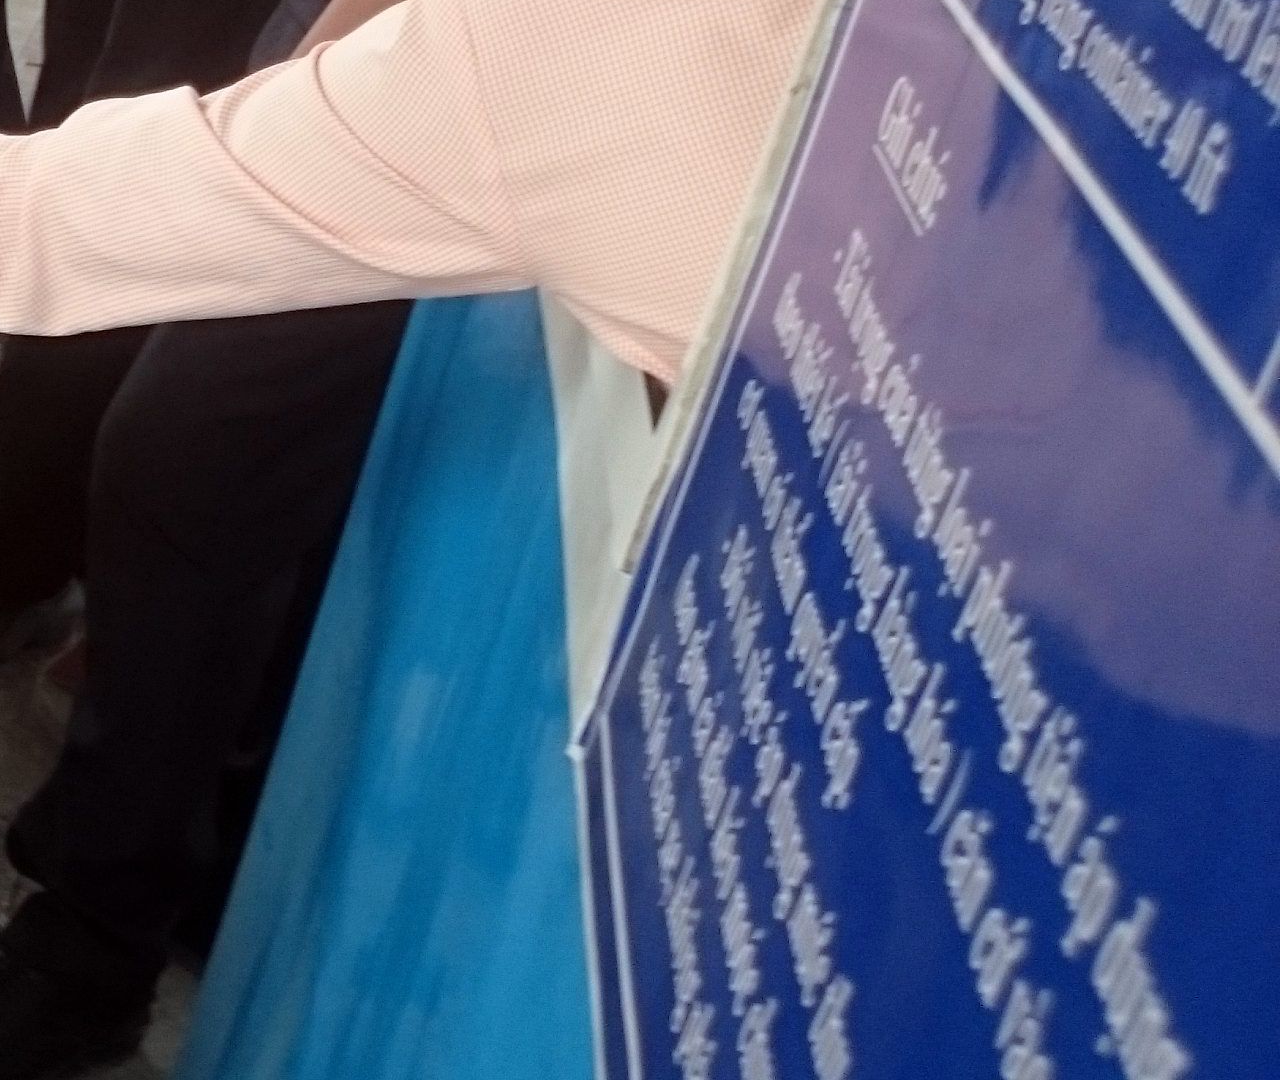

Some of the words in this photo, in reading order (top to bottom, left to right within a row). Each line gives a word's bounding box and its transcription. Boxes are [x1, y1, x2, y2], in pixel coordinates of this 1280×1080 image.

[878, 76, 923, 169] Ghi
[1078, 24, 1175, 148] container
[1159, 98, 1207, 178] 40
[849, 279, 896, 404] trọng
[874, 354, 920, 446] của
[825, 434, 868, 526] tải
[931, 469, 995, 597] loại
[842, 482, 897, 632] trọng
[872, 566, 928, 731] hàng
[952, 560, 1049, 773] phương
[903, 663, 956, 804] hóa
[1022, 706, 1088, 867] tiện
[1061, 816, 1119, 956] áp
